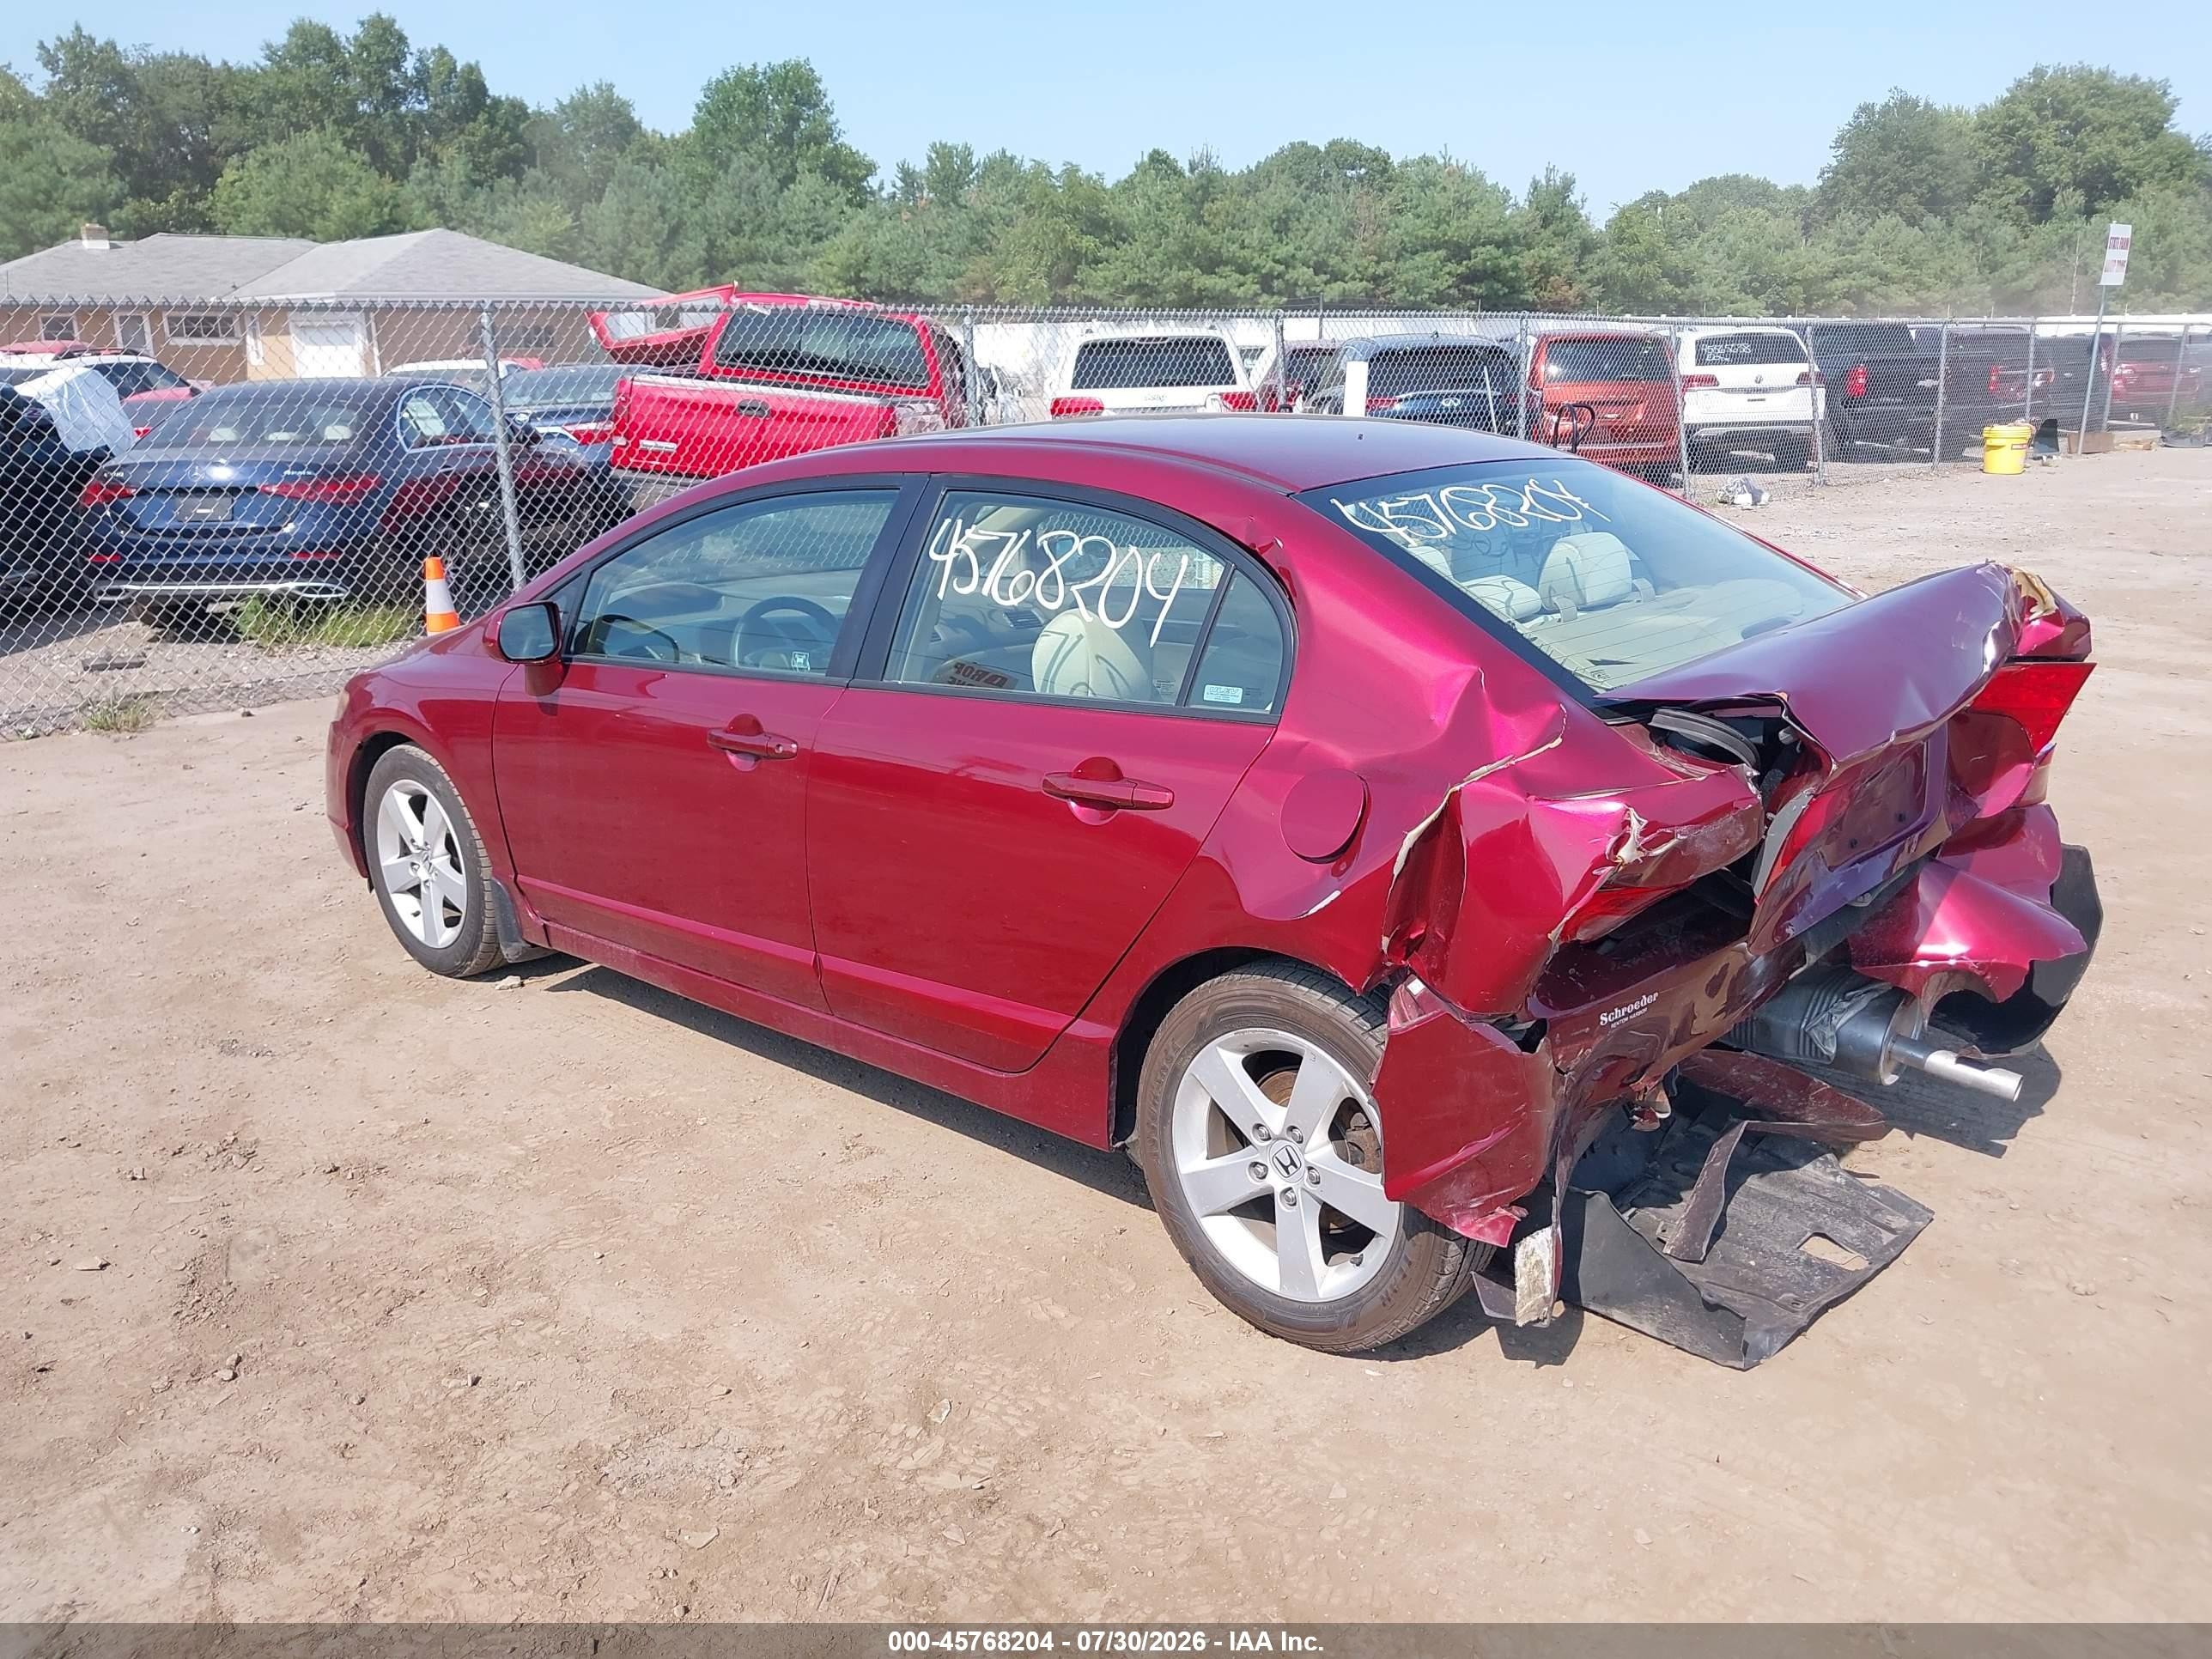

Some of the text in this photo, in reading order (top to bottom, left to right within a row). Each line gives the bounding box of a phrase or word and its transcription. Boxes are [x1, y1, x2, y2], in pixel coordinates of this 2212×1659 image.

[1330, 478, 1611, 547] 45768204
[929, 518, 1188, 648] 45768204
[1600, 992, 1658, 1026] Schroeder
